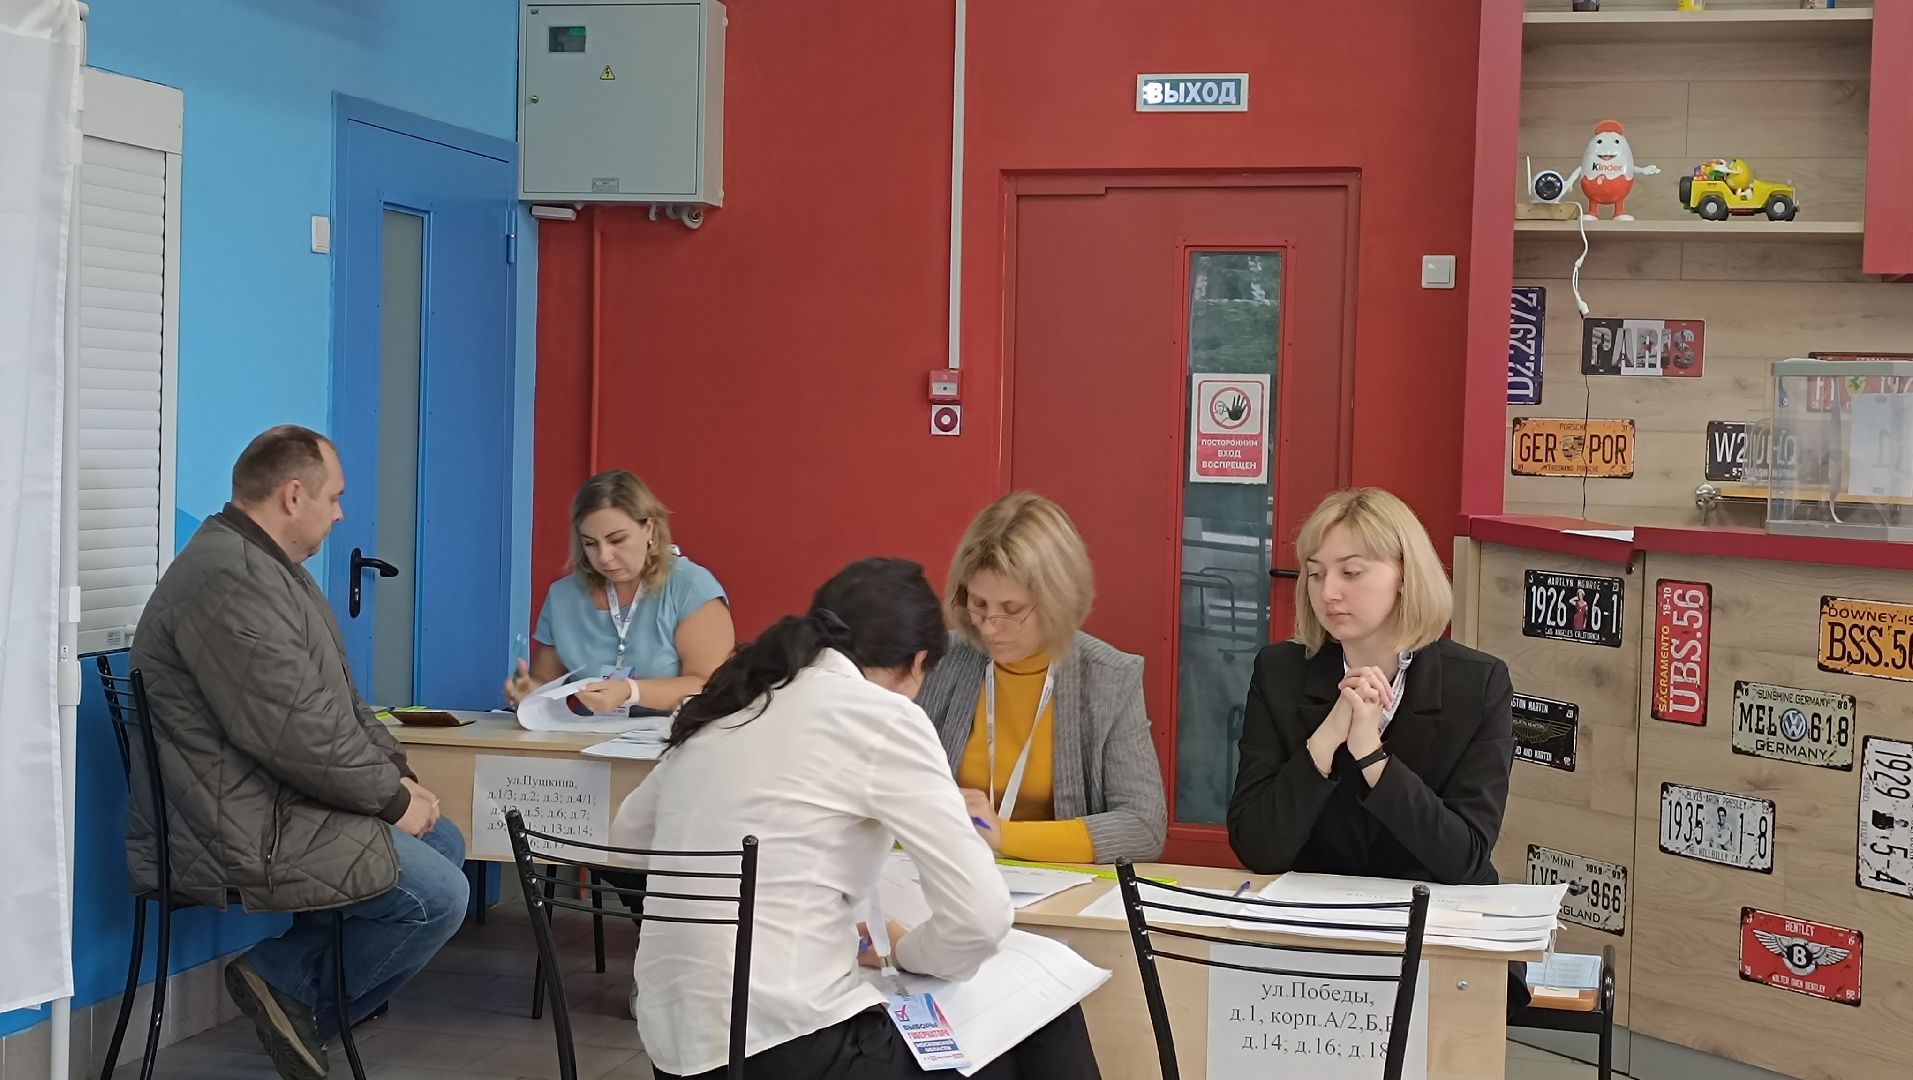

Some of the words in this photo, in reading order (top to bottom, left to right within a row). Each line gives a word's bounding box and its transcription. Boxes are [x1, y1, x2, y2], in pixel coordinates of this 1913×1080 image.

[1144, 81, 1237, 104] ВЫХОД
[1591, 327, 1695, 369] PARIS
[1560, 422, 1586, 431] PORSCH
[1217, 450, 1241, 458] ВХОД
[1520, 432, 1557, 463] GER
[1588, 434, 1627, 465] POR
[1201, 461, 1257, 469] ВОСПРЕЩЕН
[1547, 576, 1574, 587] MARILYN
[1531, 586, 1567, 626] 1926
[1591, 593, 1618, 633] 6-1
[1669, 589, 1704, 713] UBS.56
[1658, 625, 1670, 712] SACRAMENTO
[1528, 701, 1549, 713] MARTIN
[1758, 689, 1793, 704] SUNSHINE
[1795, 694, 1831, 708] GERMANY
[1739, 702, 1777, 736] MEL
[1810, 712, 1849, 747] 618
[1756, 739, 1828, 760] GERMANY
[507, 775, 577, 789] ул.Пушкина,
[1874, 750, 1913, 800] 1929
[488, 789, 517, 801] д.1/3;
[520, 791, 540, 801] д.2;
[543, 793, 563, 803] д.3;
[566, 794, 596, 805] д.4/1;
[524, 807, 543, 817] д.5;
[547, 808, 567, 819] д.6;
[570, 809, 590, 821] д.7;
[1668, 800, 1704, 845] 1935
[1739, 813, 1768, 859] 1-8
[1552, 855, 1574, 868] MINI
[1868, 842, 1909, 886] 5-4
[1591, 879, 1622, 913] 966
[1560, 905, 1601, 923] GLAND
[1785, 920, 1815, 937] BENTLEY
[1792, 946, 1807, 966] B
[1772, 973, 1790, 985] WALTER
[1791, 978, 1804, 988] OWEN
[1805, 981, 1826, 993] BENTLEY
[1262, 981, 1374, 1006] ул.Победы,
[1229, 1005, 1264, 1024] д.1,
[1242, 1033, 1288, 1055] д.14;
[1295, 1037, 1342, 1057] д.16;
